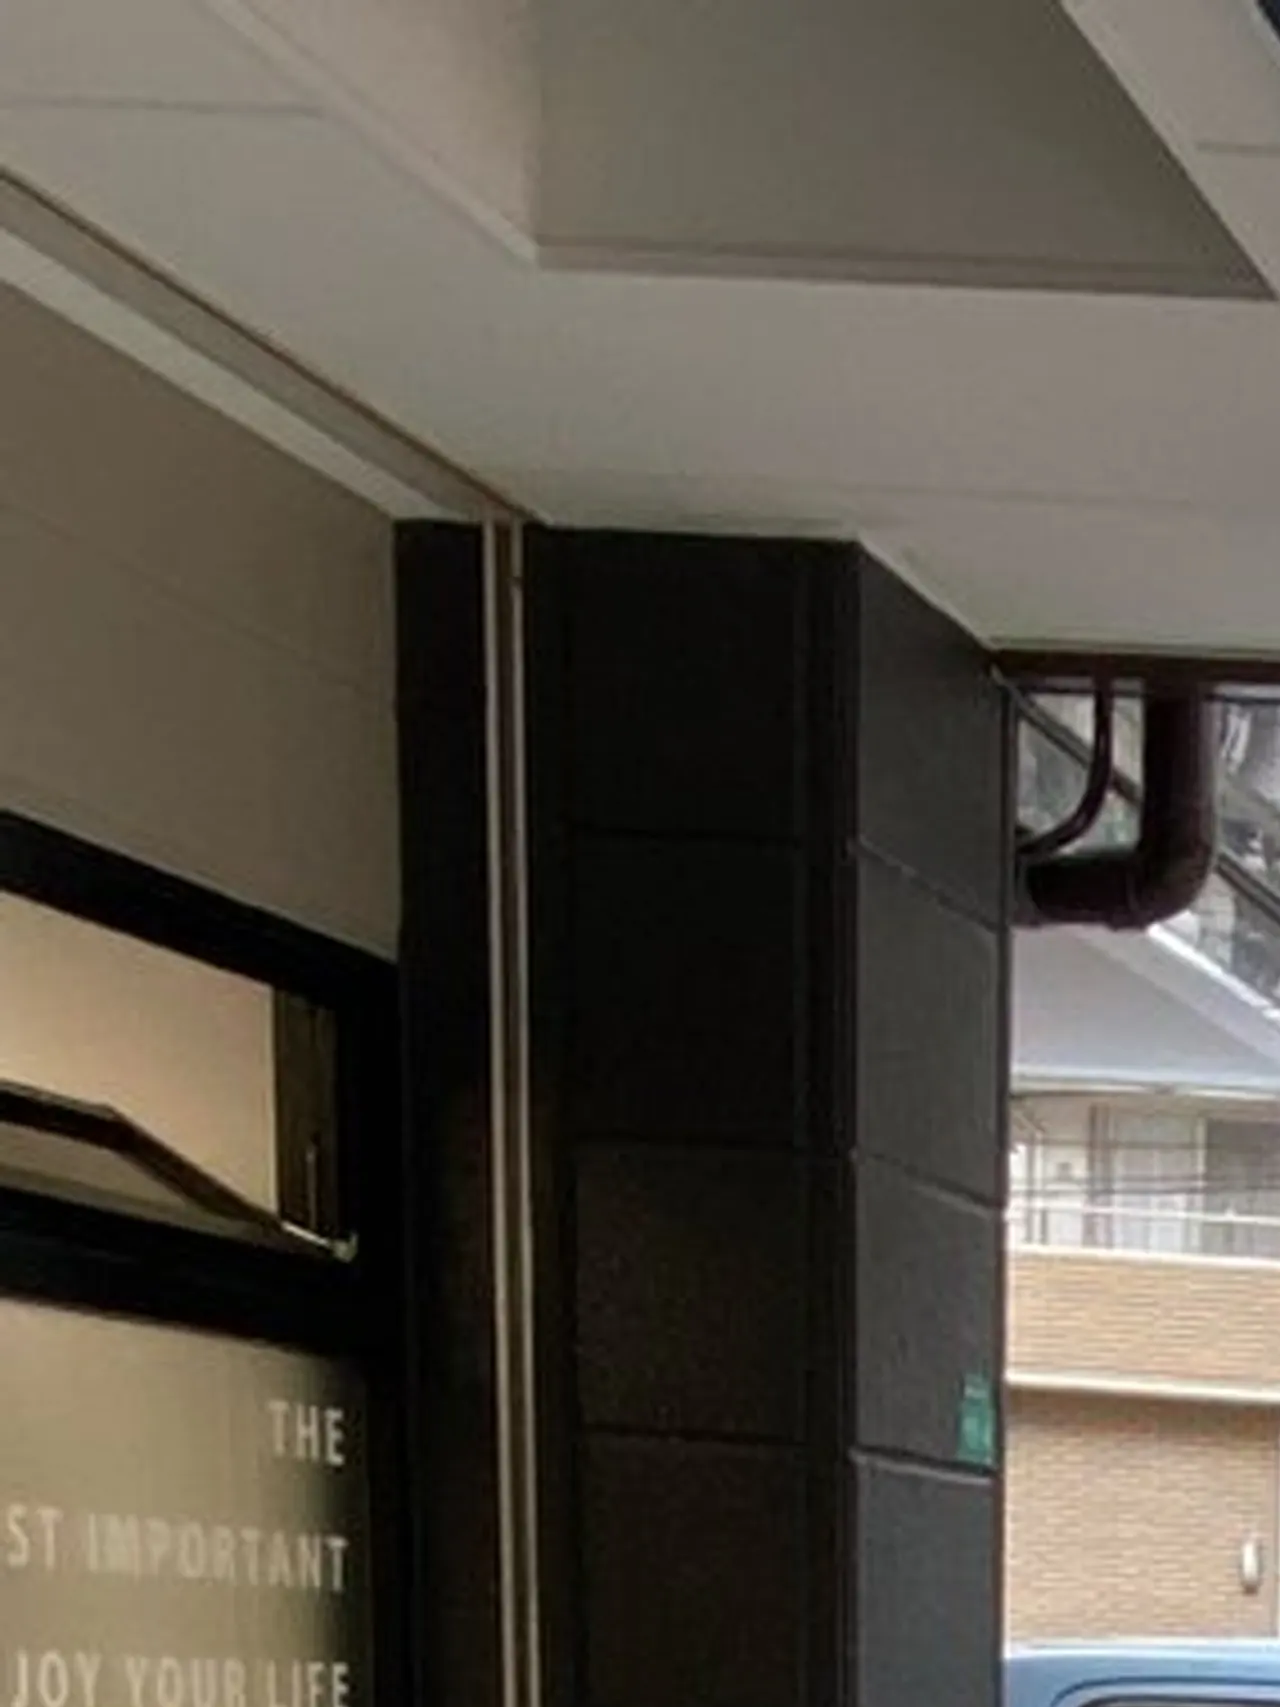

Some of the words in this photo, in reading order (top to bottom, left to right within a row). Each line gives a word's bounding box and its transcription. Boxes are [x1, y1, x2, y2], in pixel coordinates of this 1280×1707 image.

[268, 1398, 346, 1466] THE
[5, 1502, 64, 1572] ST
[87, 1511, 349, 1592] IMPORTANT
